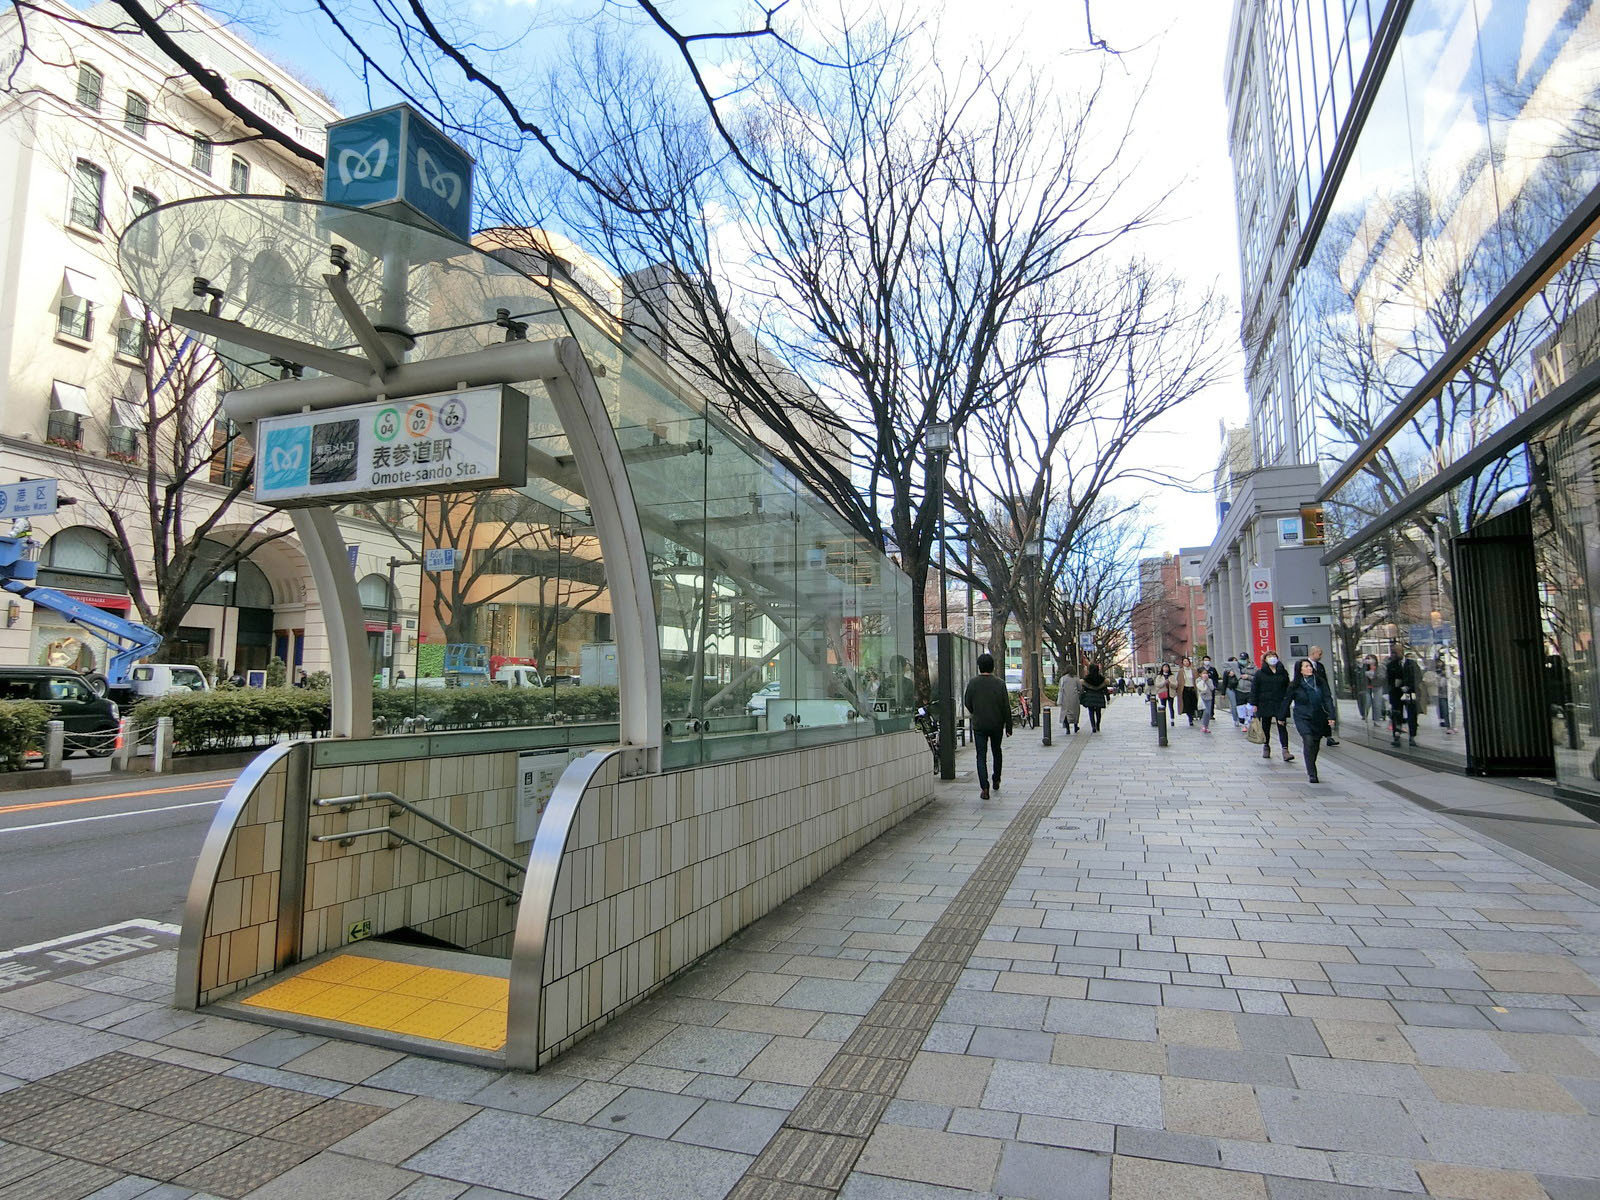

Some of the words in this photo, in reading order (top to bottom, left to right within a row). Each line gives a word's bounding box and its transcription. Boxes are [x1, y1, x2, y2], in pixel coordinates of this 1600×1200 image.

[415, 409, 424, 419] G
[449, 404, 456, 415] Z
[384, 413, 391, 423] C
[445, 415, 459, 426] 02
[380, 424, 394, 435] 04
[412, 420, 426, 431] 02
[372, 438, 452, 470] 表参道駅
[372, 463, 452, 485] Omote-sando
[456, 462, 480, 476] Sta.
[874, 703, 885, 712] A1
